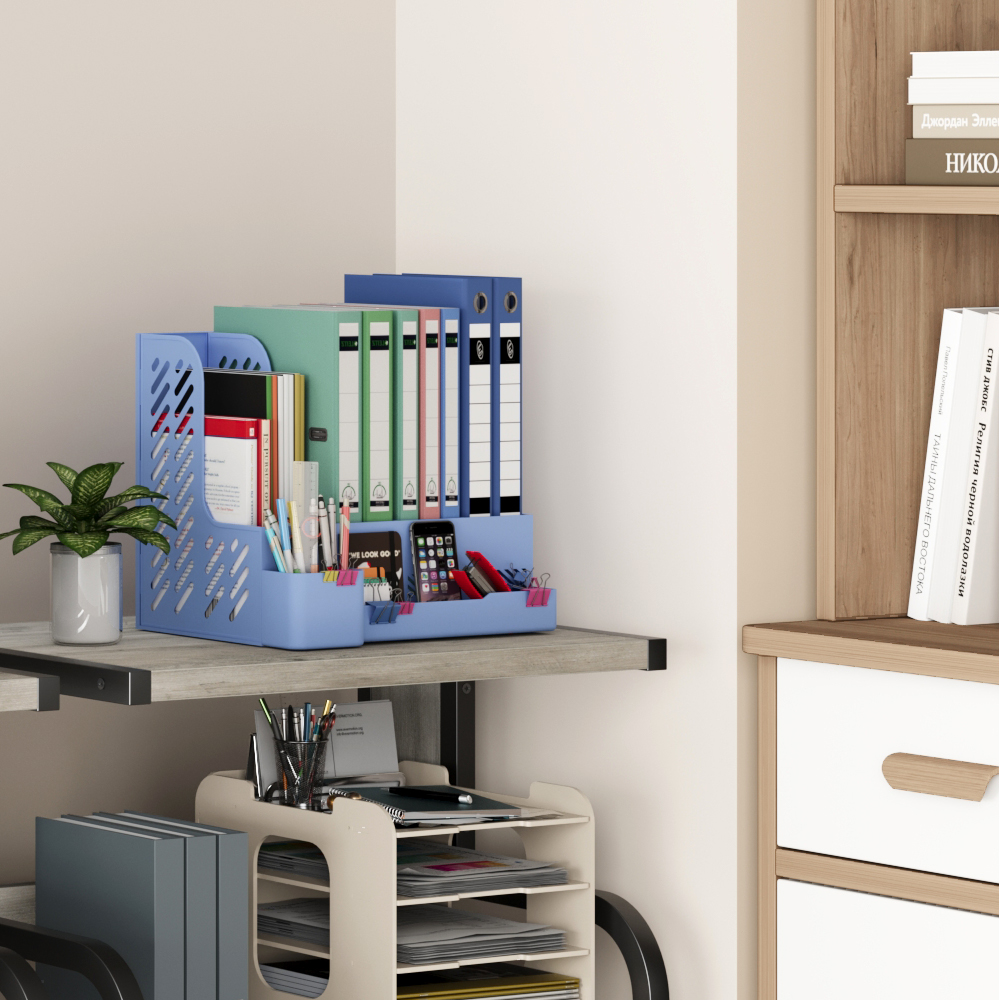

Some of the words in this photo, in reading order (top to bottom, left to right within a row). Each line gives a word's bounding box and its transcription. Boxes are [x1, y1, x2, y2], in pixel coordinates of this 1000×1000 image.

[921, 113, 969, 130] Джордан
[945, 152, 1000, 174] НИКО
[972, 422, 987, 475] Религия
[922, 474, 937, 538] ДАЛЬНЕГО
[967, 478, 979, 526] черной
[361, 550, 379, 558] LOOK
[915, 540, 929, 595] ВОСТОКА
[958, 528, 972, 597] водолазки
